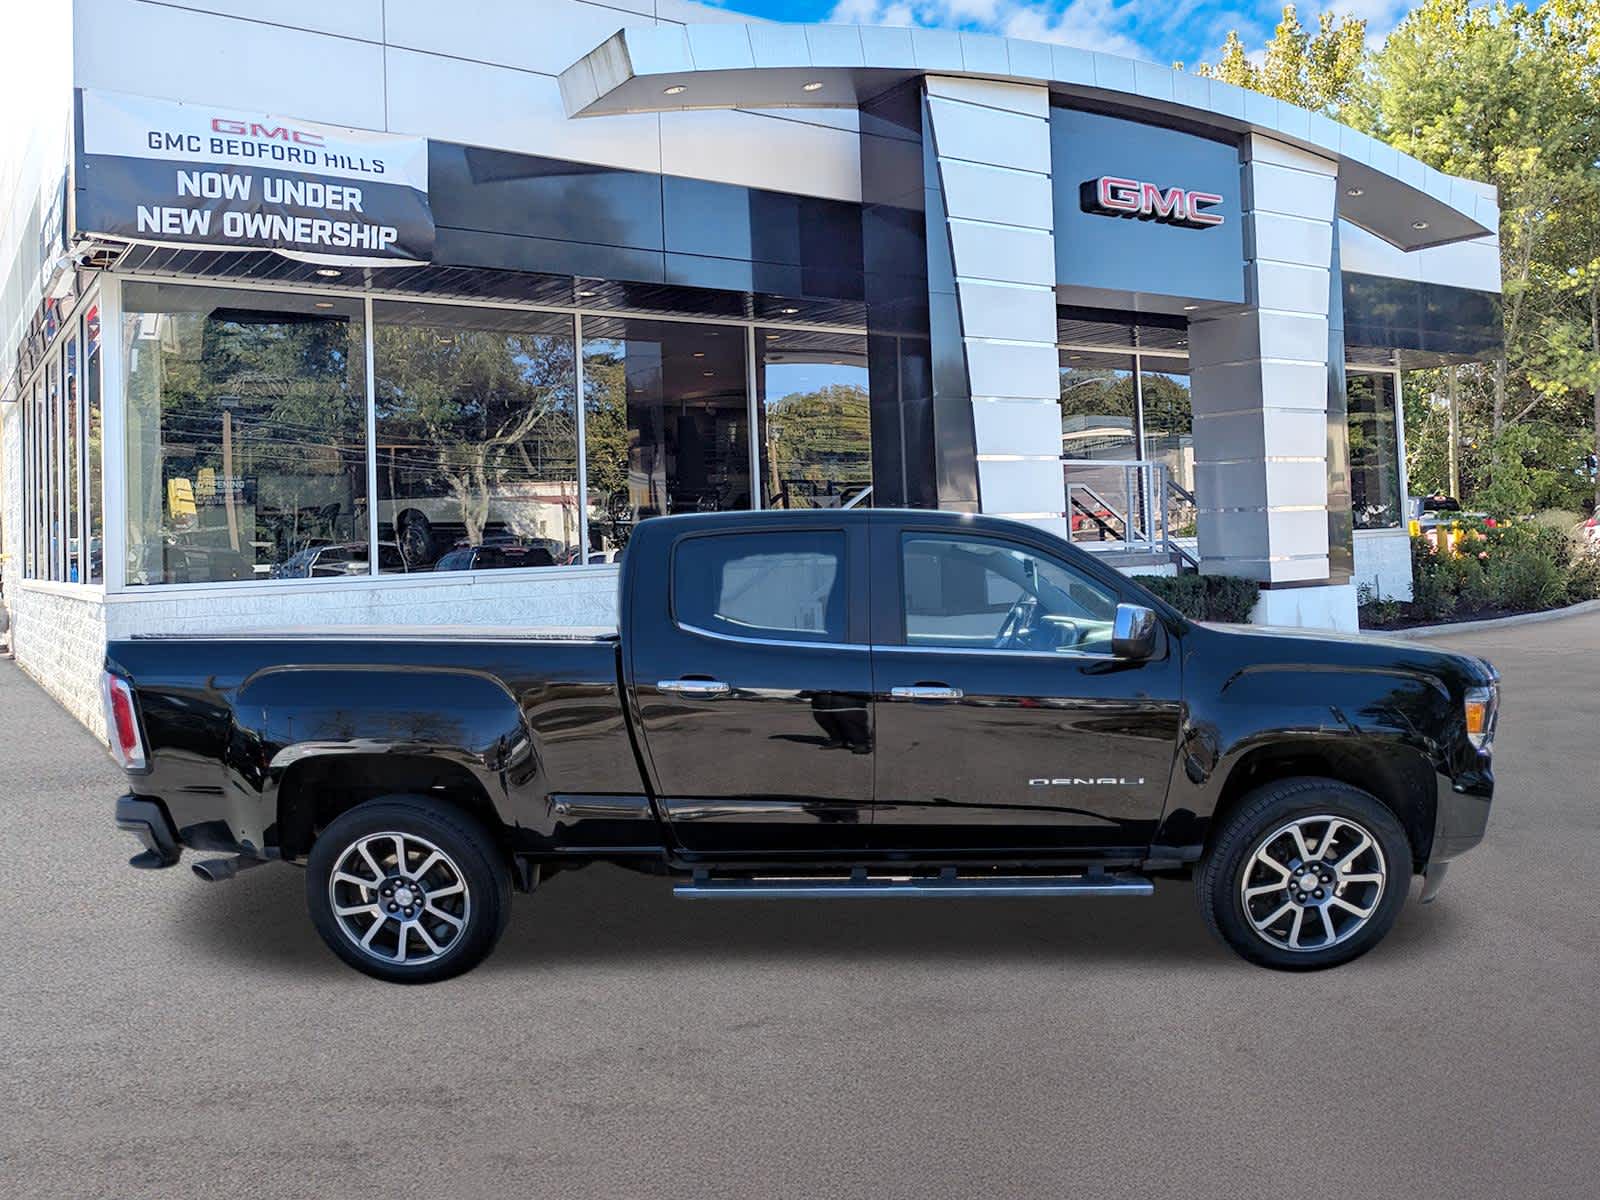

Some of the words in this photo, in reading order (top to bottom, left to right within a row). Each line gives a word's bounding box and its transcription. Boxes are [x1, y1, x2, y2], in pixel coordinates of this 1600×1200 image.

[148, 131, 201, 152] GMC
[210, 138, 316, 165] BEDFORD
[324, 153, 385, 174] HILLS
[211, 118, 326, 148] GMC
[177, 170, 252, 201] NOW
[263, 177, 364, 213] UNDER
[1096, 175, 1225, 225] GMC
[136, 205, 211, 236] NEW
[223, 211, 398, 250] OWNERSHIP
[1028, 777, 1145, 785] DENALI
